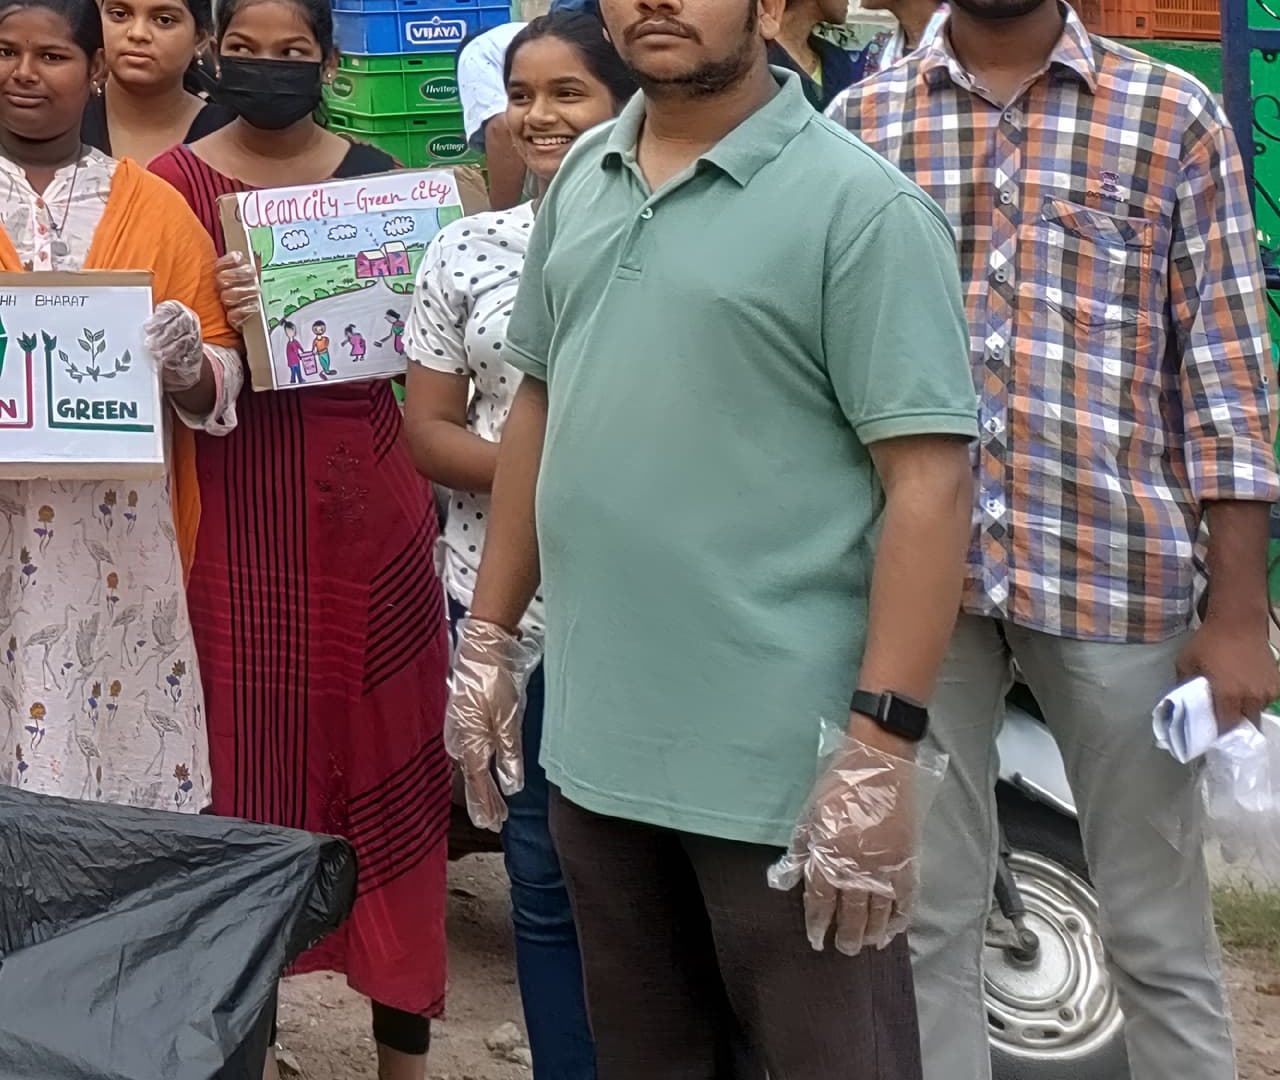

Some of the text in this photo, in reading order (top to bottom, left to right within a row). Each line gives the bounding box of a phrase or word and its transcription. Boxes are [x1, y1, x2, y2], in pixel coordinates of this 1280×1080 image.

[412, 25, 461, 38] VIJAYA
[356, 187, 408, 214] Green
[34, 294, 89, 308] BHARAT
[56, 398, 138, 420] GREEN
